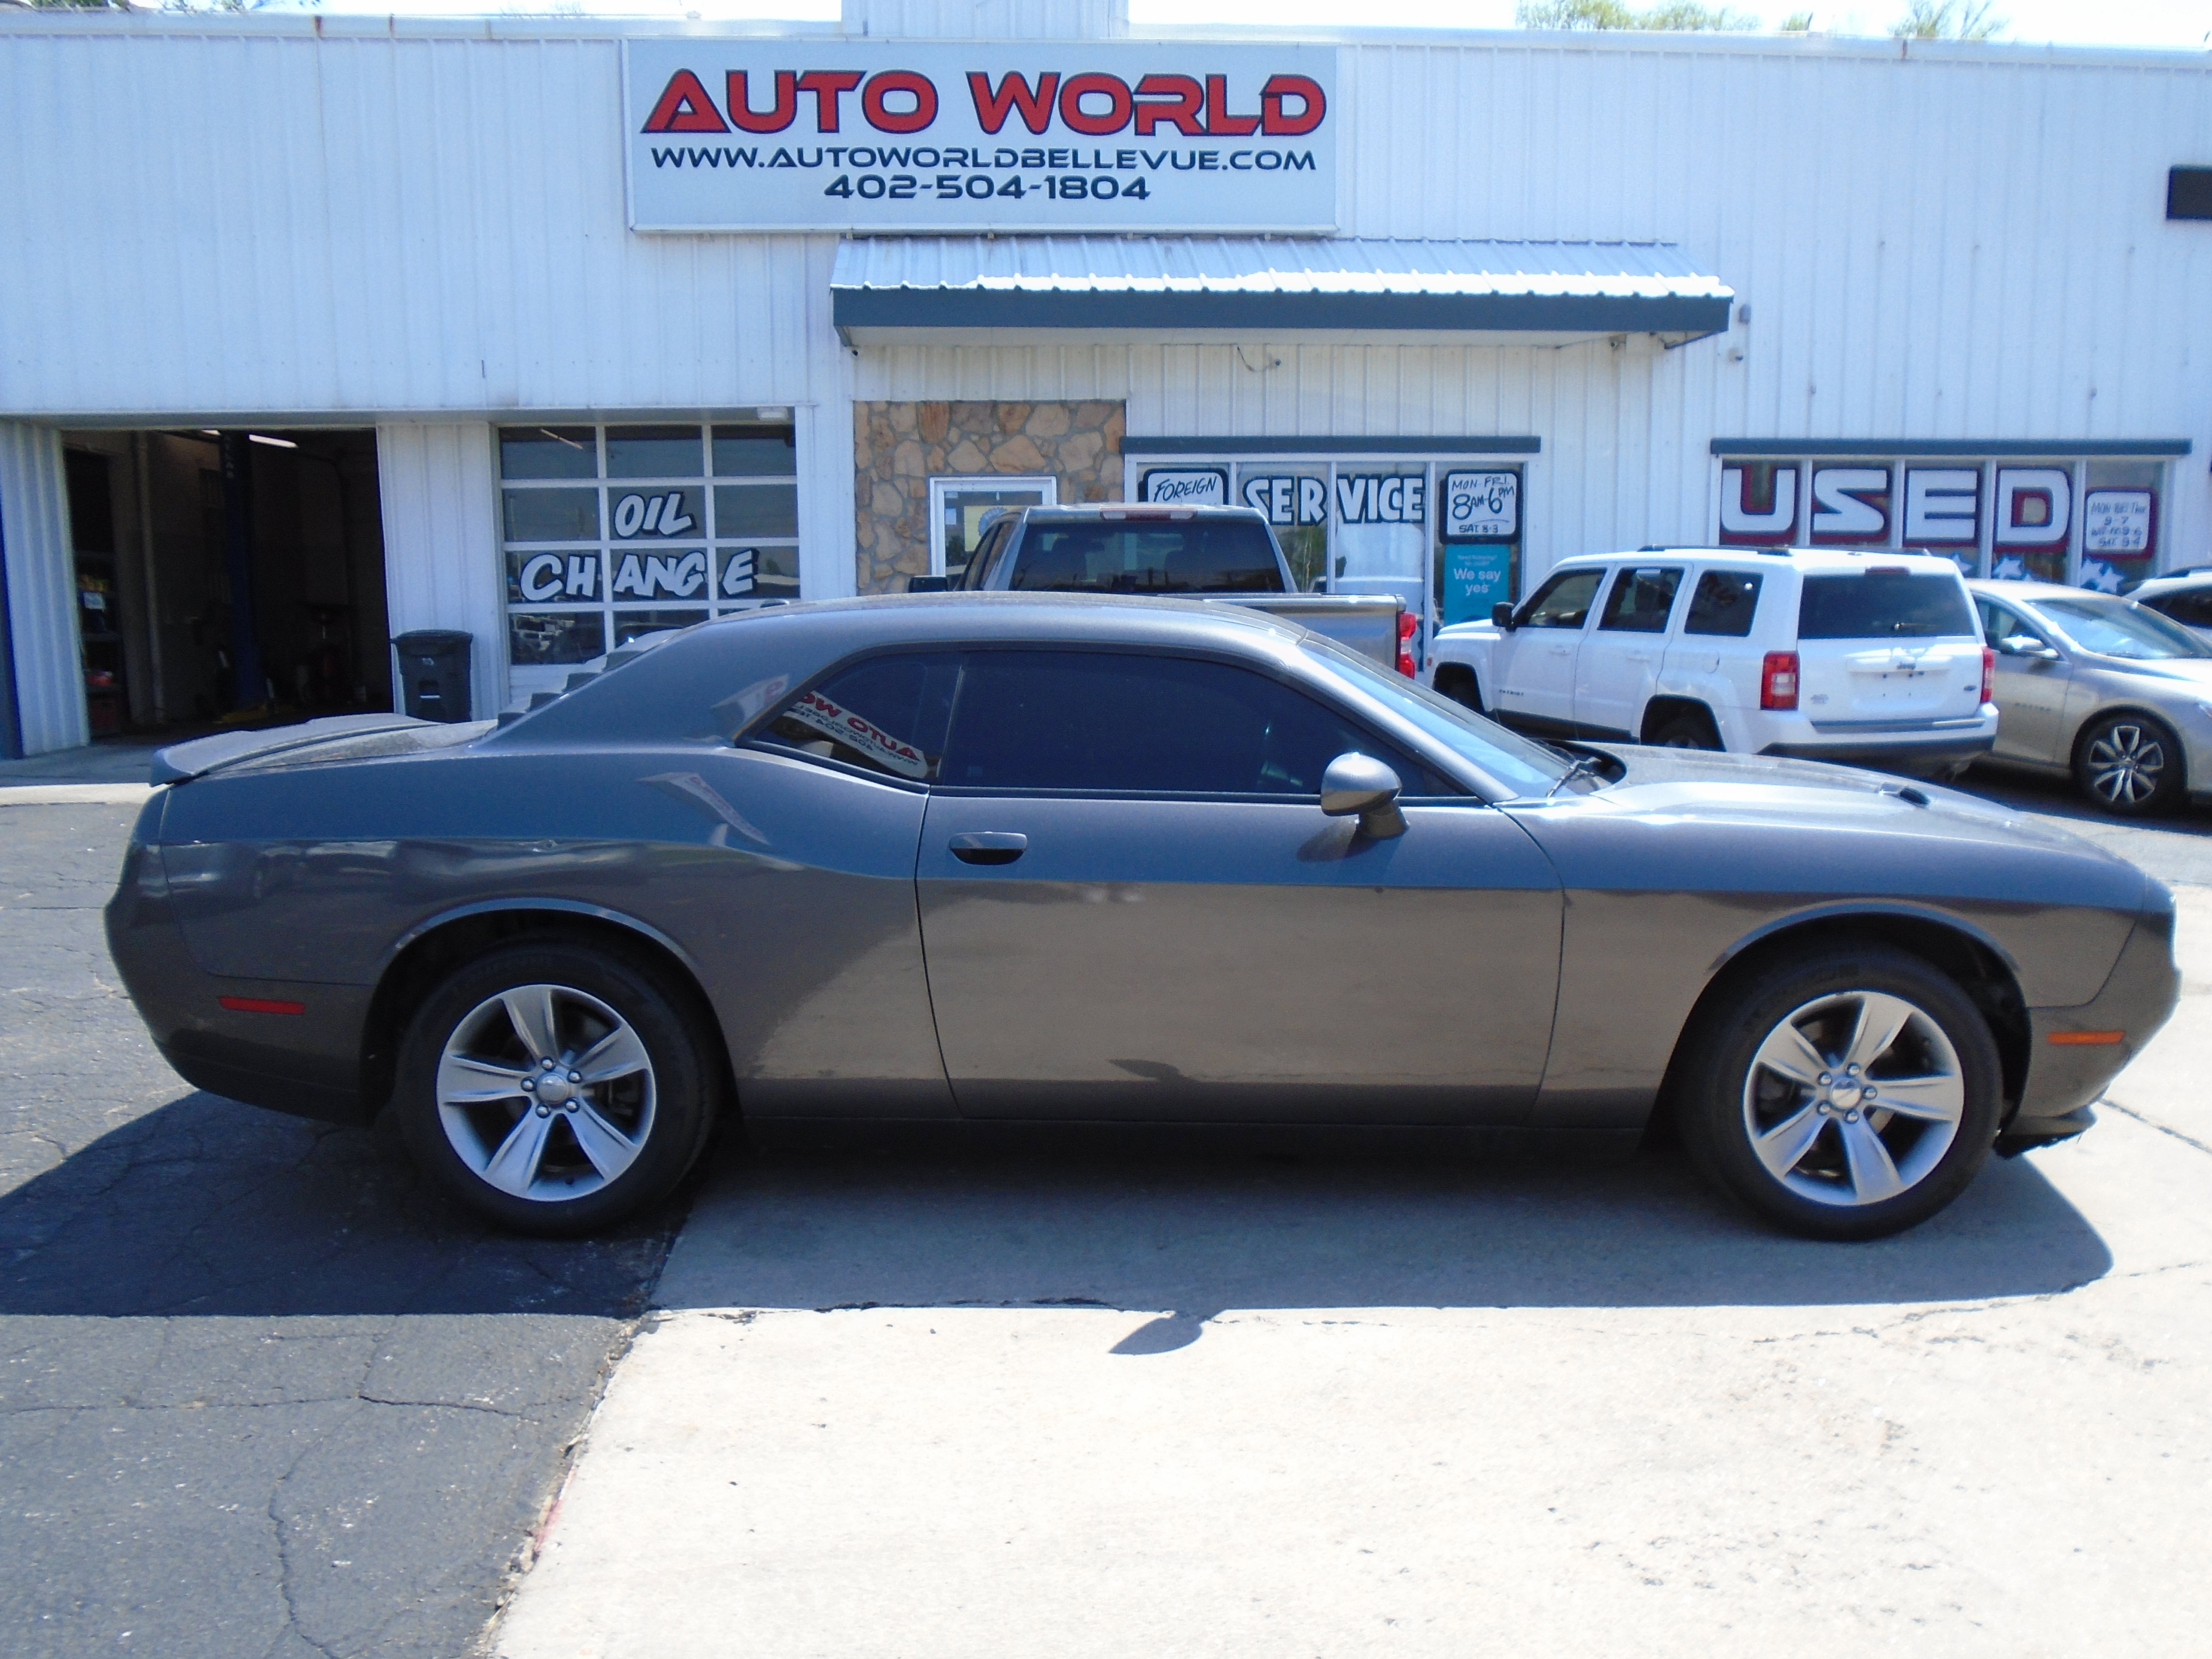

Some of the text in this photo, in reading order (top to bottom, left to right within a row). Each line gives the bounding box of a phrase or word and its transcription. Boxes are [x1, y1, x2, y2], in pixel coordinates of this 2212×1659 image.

[640, 68, 1327, 136] AUTO WORLD
[651, 146, 1317, 170] WWW.AUTOWORLDBELLEVUE.COM
[823, 173, 1151, 201] 402-504-1804
[1153, 476, 1217, 502] FOREIGN
[1242, 474, 1425, 526] SERVICE
[614, 492, 697, 539] OIL
[1719, 464, 2072, 552] USED
[519, 547, 760, 601] CHANGE
[1453, 568, 1501, 583] We say
[1465, 584, 1490, 596] yes
